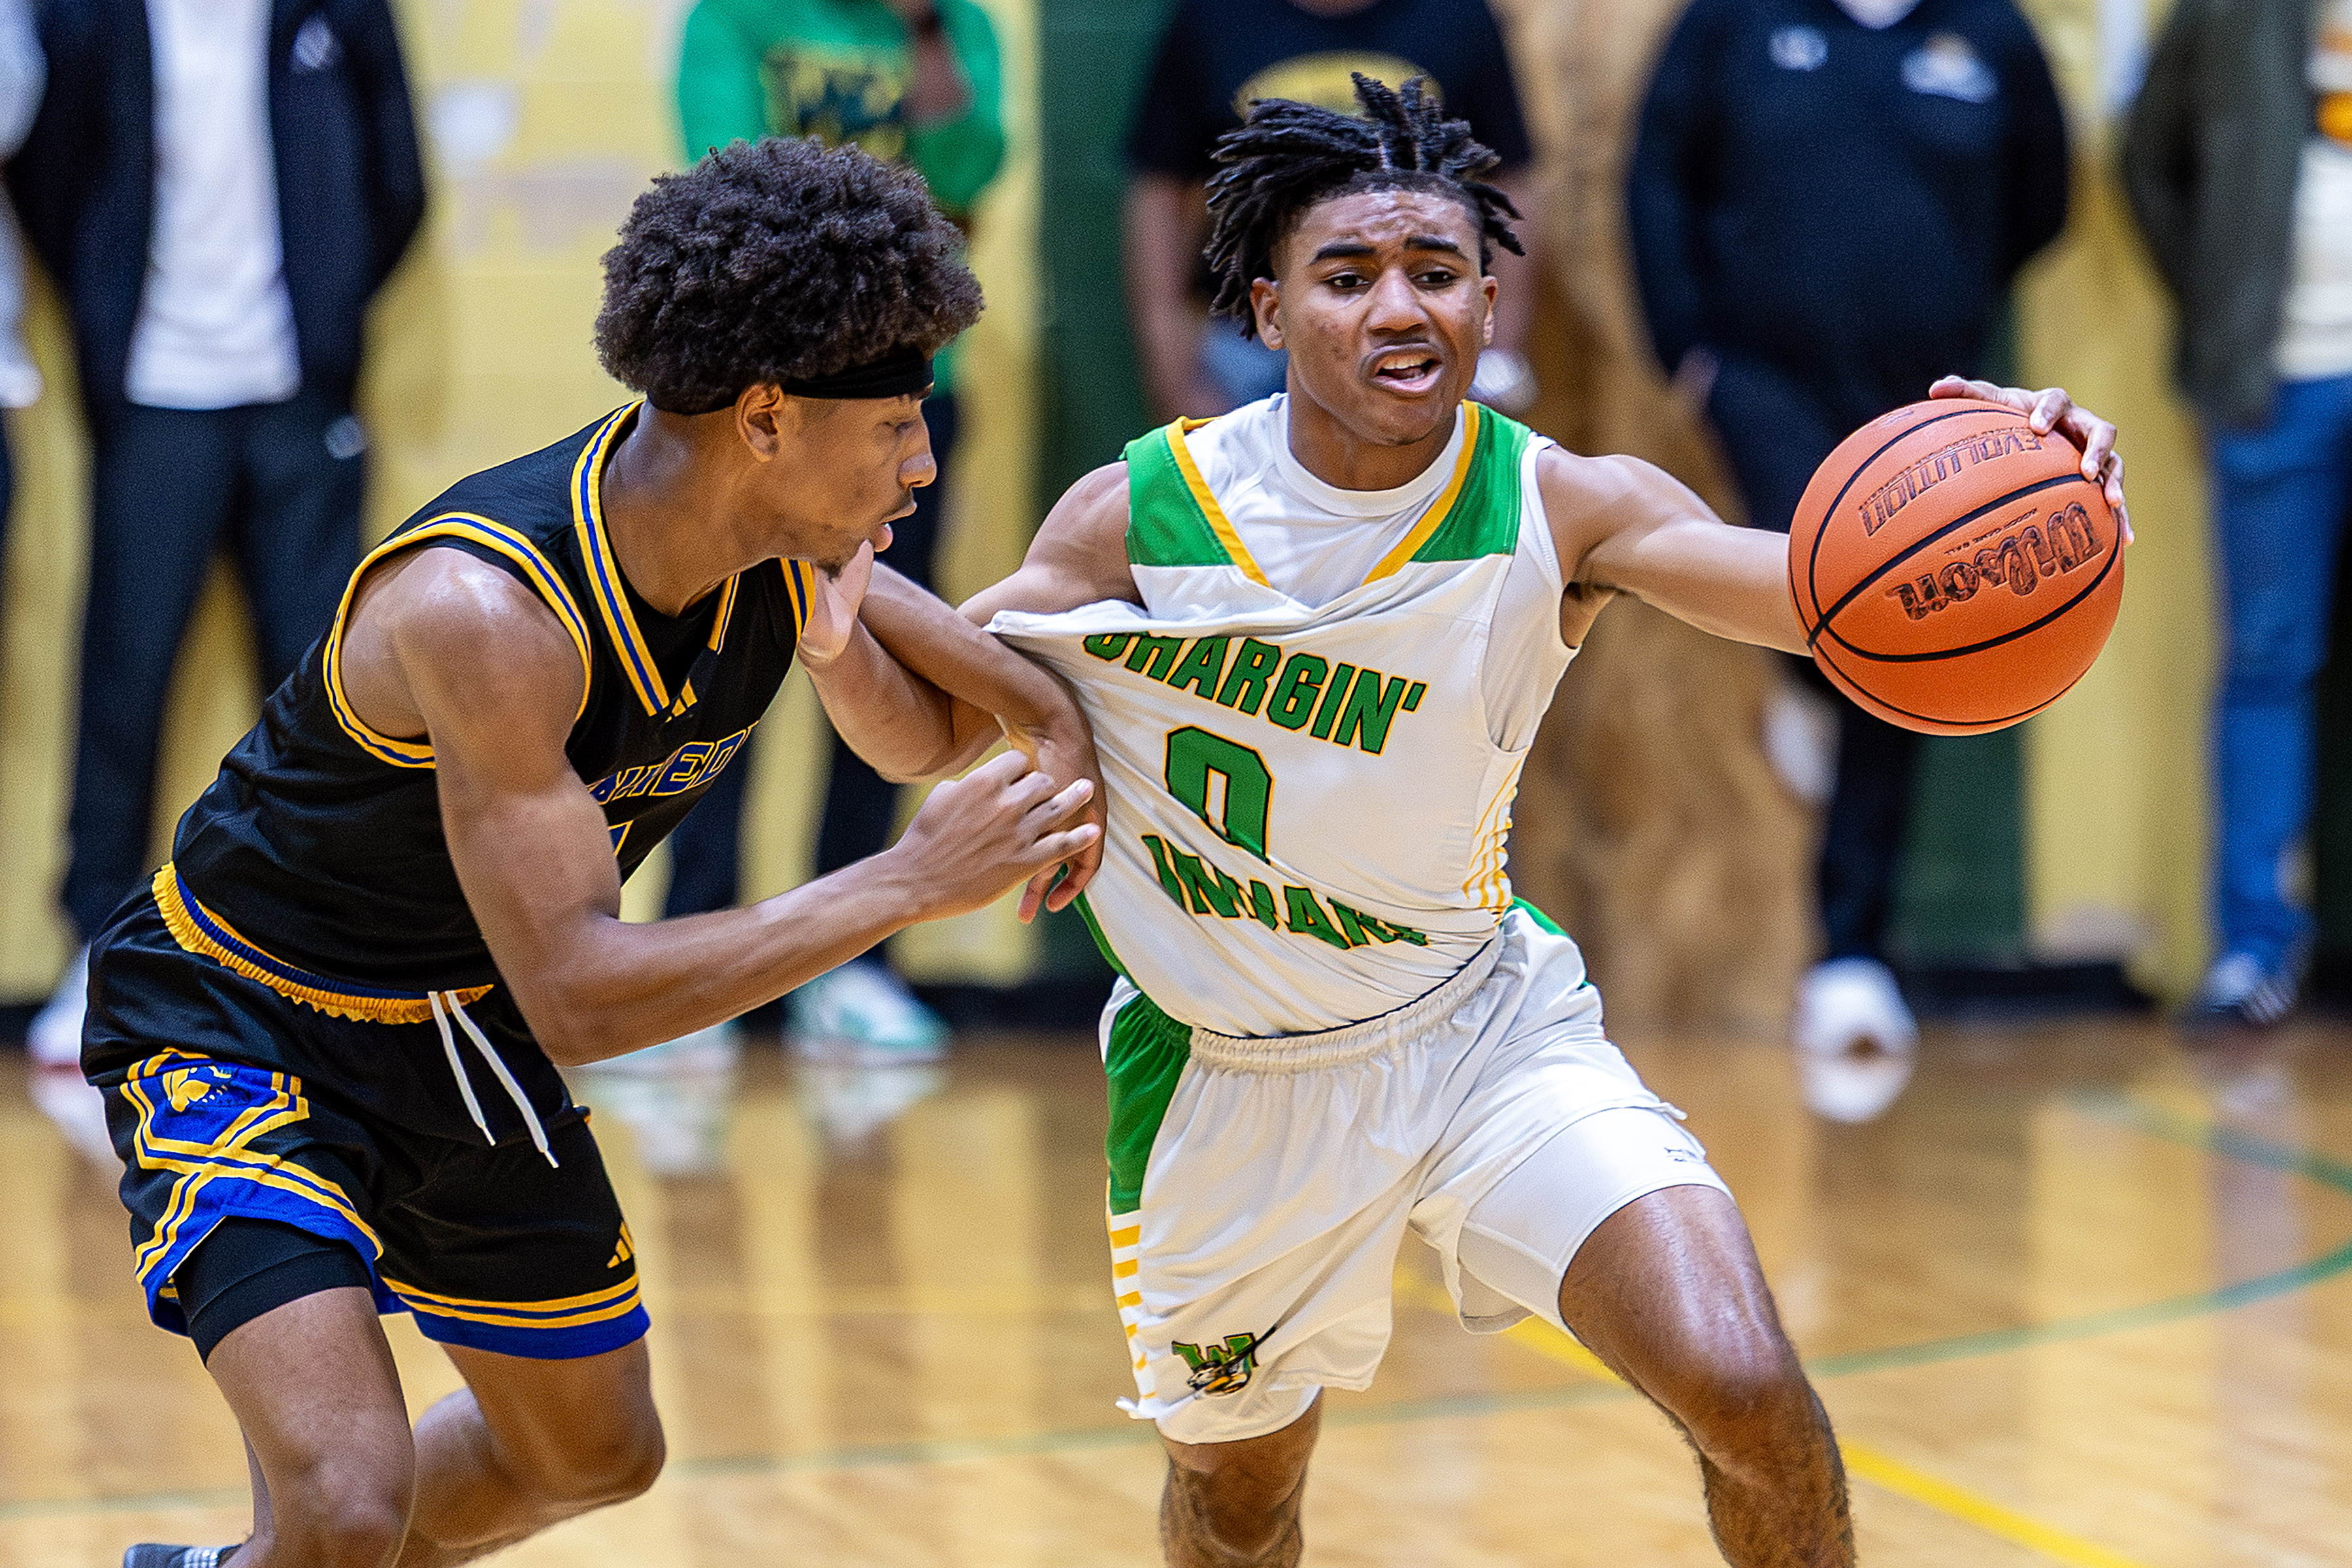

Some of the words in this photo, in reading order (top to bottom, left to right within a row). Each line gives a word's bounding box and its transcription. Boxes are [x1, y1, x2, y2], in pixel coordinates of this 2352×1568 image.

[1860, 430, 2042, 537] EVOLUTION
[1886, 502, 2103, 620] Wilson
[1164, 724, 1273, 866] 0
